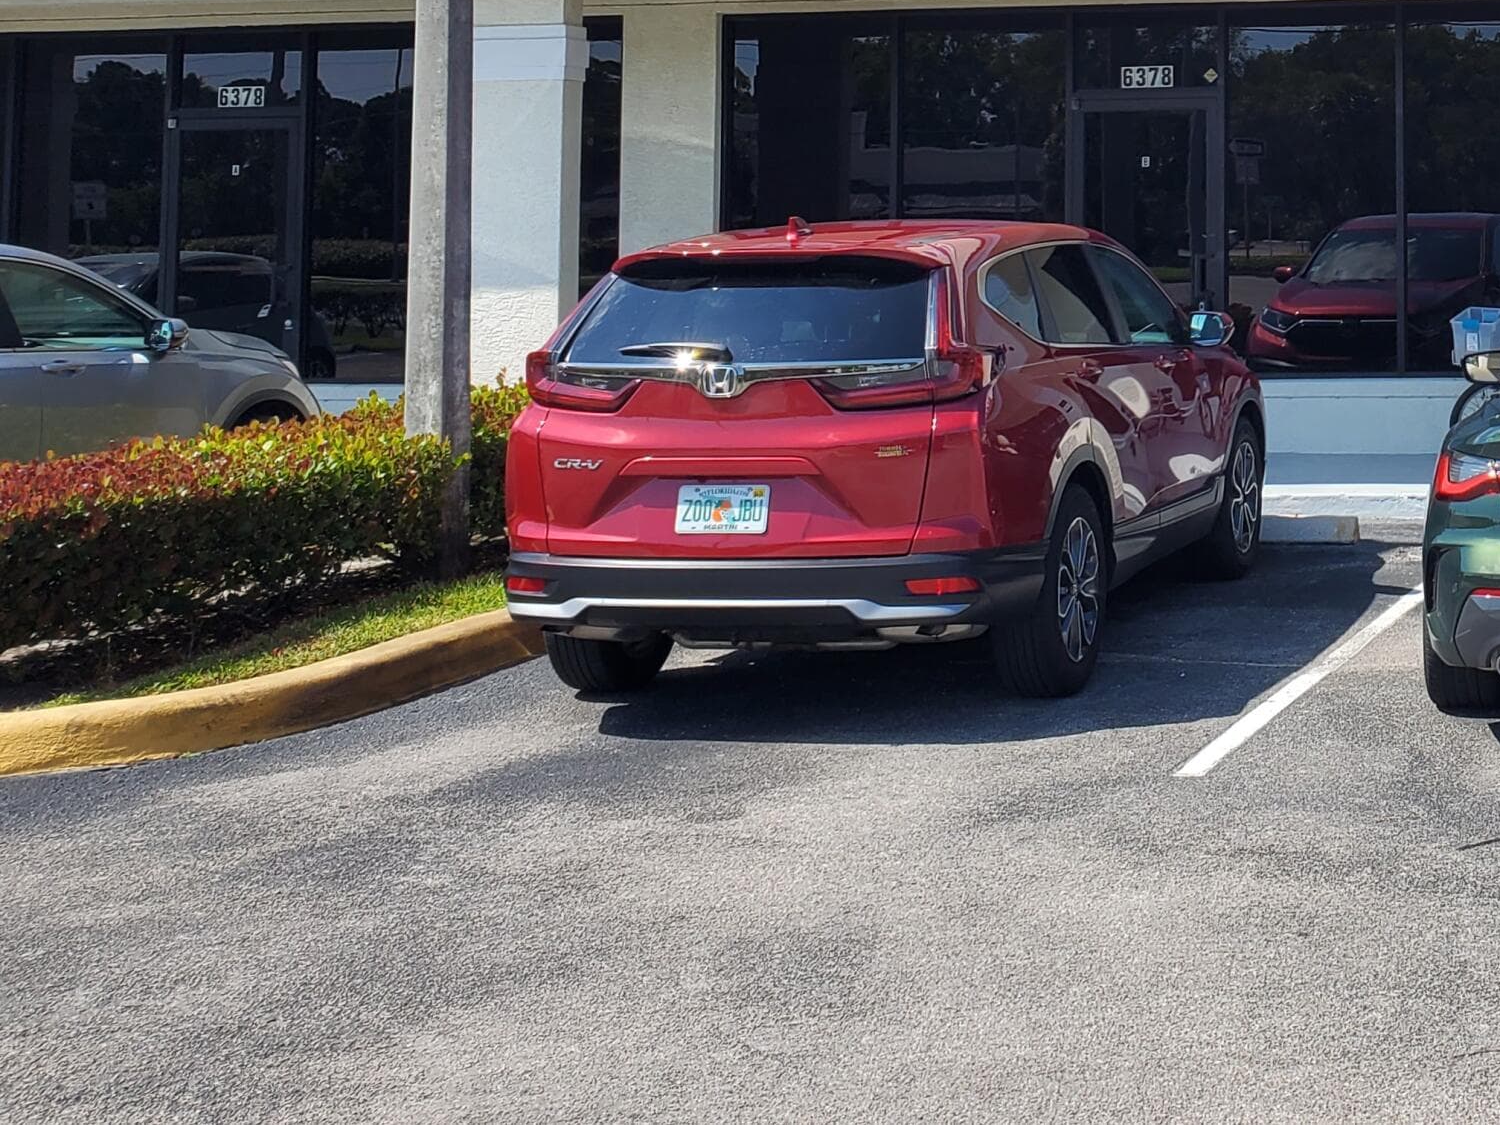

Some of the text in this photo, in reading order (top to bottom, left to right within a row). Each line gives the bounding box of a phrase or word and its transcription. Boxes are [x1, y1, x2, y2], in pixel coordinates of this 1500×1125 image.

[1123, 66, 1172, 87] 6378
[219, 87, 264, 106] 6378
[554, 458, 603, 469] CR-V
[732, 499, 763, 522] JBU
